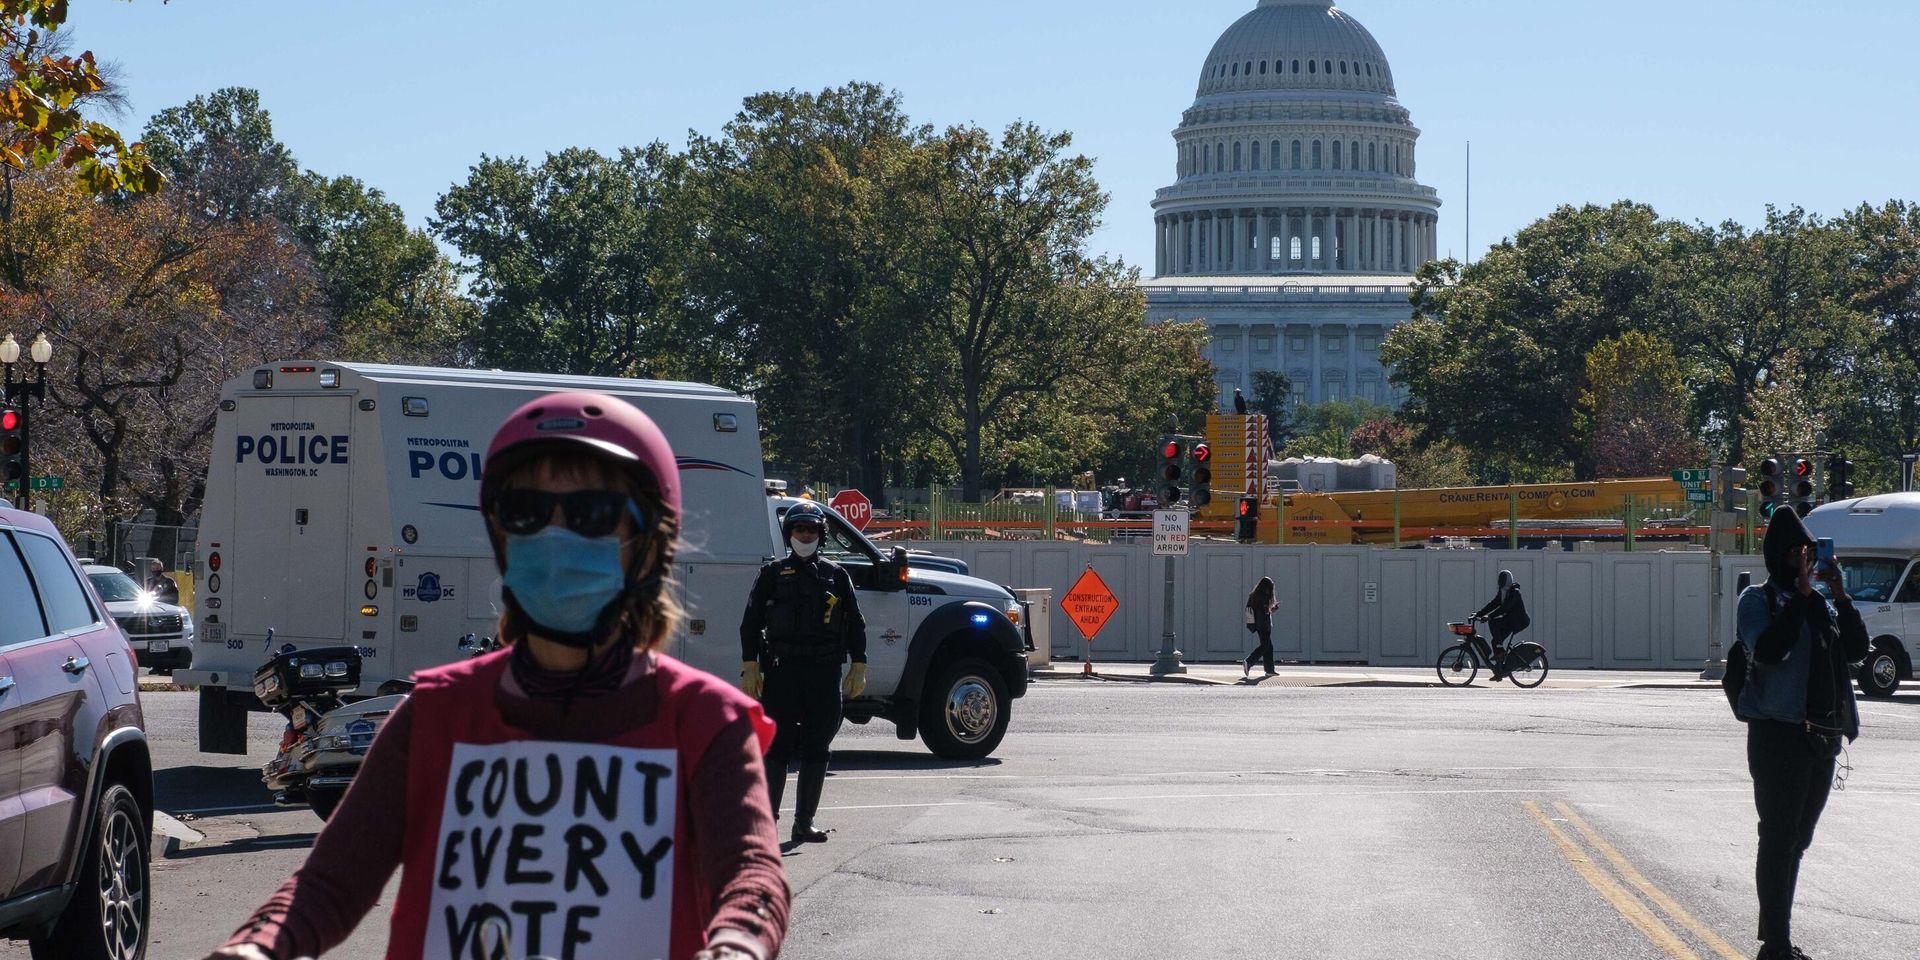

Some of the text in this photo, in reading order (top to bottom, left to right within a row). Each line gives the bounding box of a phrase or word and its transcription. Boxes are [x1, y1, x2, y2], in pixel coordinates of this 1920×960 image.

[271, 423, 315, 431] METROPOLITAN
[407, 438, 469, 448] METROPOLITAN
[236, 435, 349, 464] POLICE
[409, 450, 482, 480] POL
[310, 469, 318, 477] DC
[1682, 471, 1691, 480] D
[40, 479, 47, 487] D
[834, 502, 868, 520] STOP
[1164, 514, 1178, 522] NO
[1161, 524, 1182, 532] TURN
[1155, 533, 1186, 542] ON RED
[1156, 544, 1185, 552] ARROW
[403, 588, 416, 597] MP
[443, 588, 455, 597] DC
[910, 596, 932, 606] 8891
[1069, 593, 1112, 603] CONSTRUCTION
[1075, 604, 1105, 613] ENTRANCE
[1080, 615, 1100, 624] AHEAD
[227, 639, 244, 650] SOD
[454, 753, 672, 826] COUNT
[438, 823, 673, 900] EVERY
[444, 900, 600, 960] VOTE
